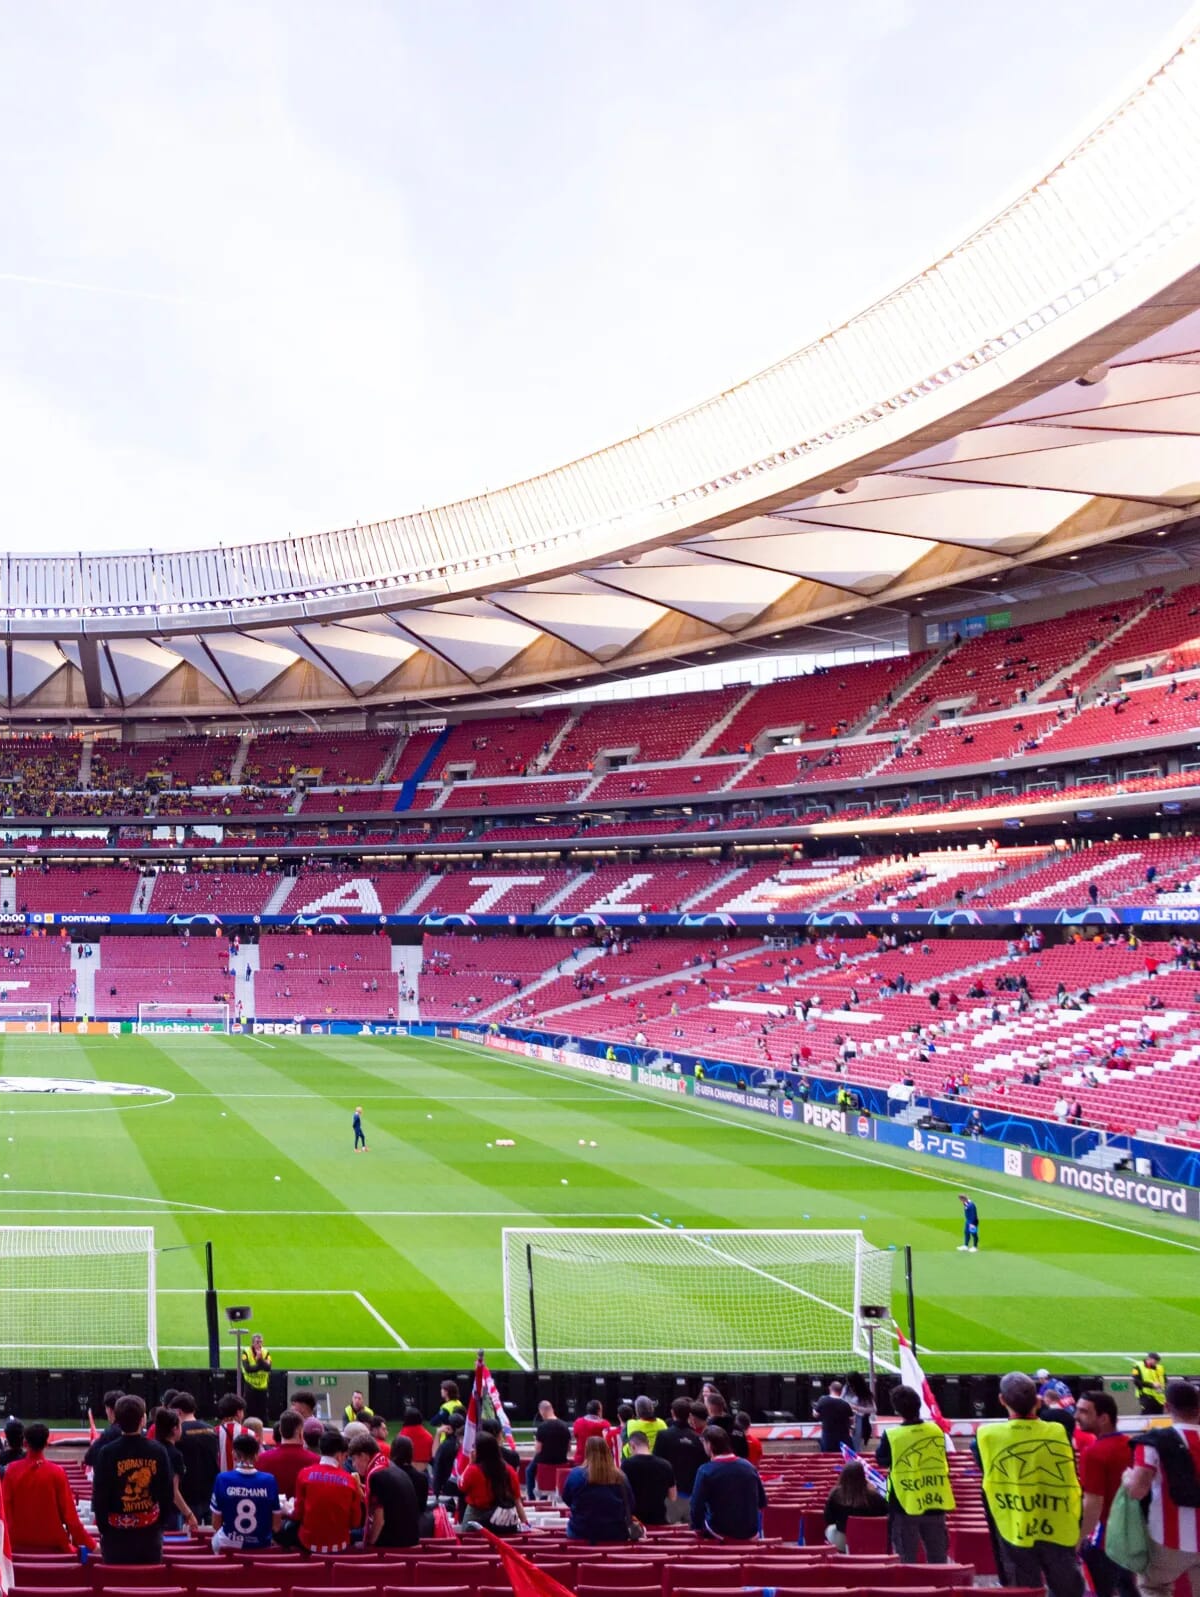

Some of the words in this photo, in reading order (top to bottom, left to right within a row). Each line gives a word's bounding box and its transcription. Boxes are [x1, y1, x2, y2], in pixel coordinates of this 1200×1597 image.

[1141, 908, 1200, 921] ATLÉTICO
[253, 1023, 301, 1034] PEPSI
[375, 1025, 408, 1035] PS5
[638, 1069, 678, 1093] Heineken
[701, 1086, 714, 1098] UEFA
[715, 1087, 745, 1105] CHAMPIONS
[747, 1095, 769, 1109] LEAGUE
[803, 1102, 846, 1133] PEPSI
[927, 1135, 966, 1159] PS5
[1060, 1165, 1187, 1213] mastercard
[226, 1486, 268, 1497] GRIEZMANN
[995, 1493, 1071, 1512] SECURITY
[234, 1499, 257, 1534] 8
